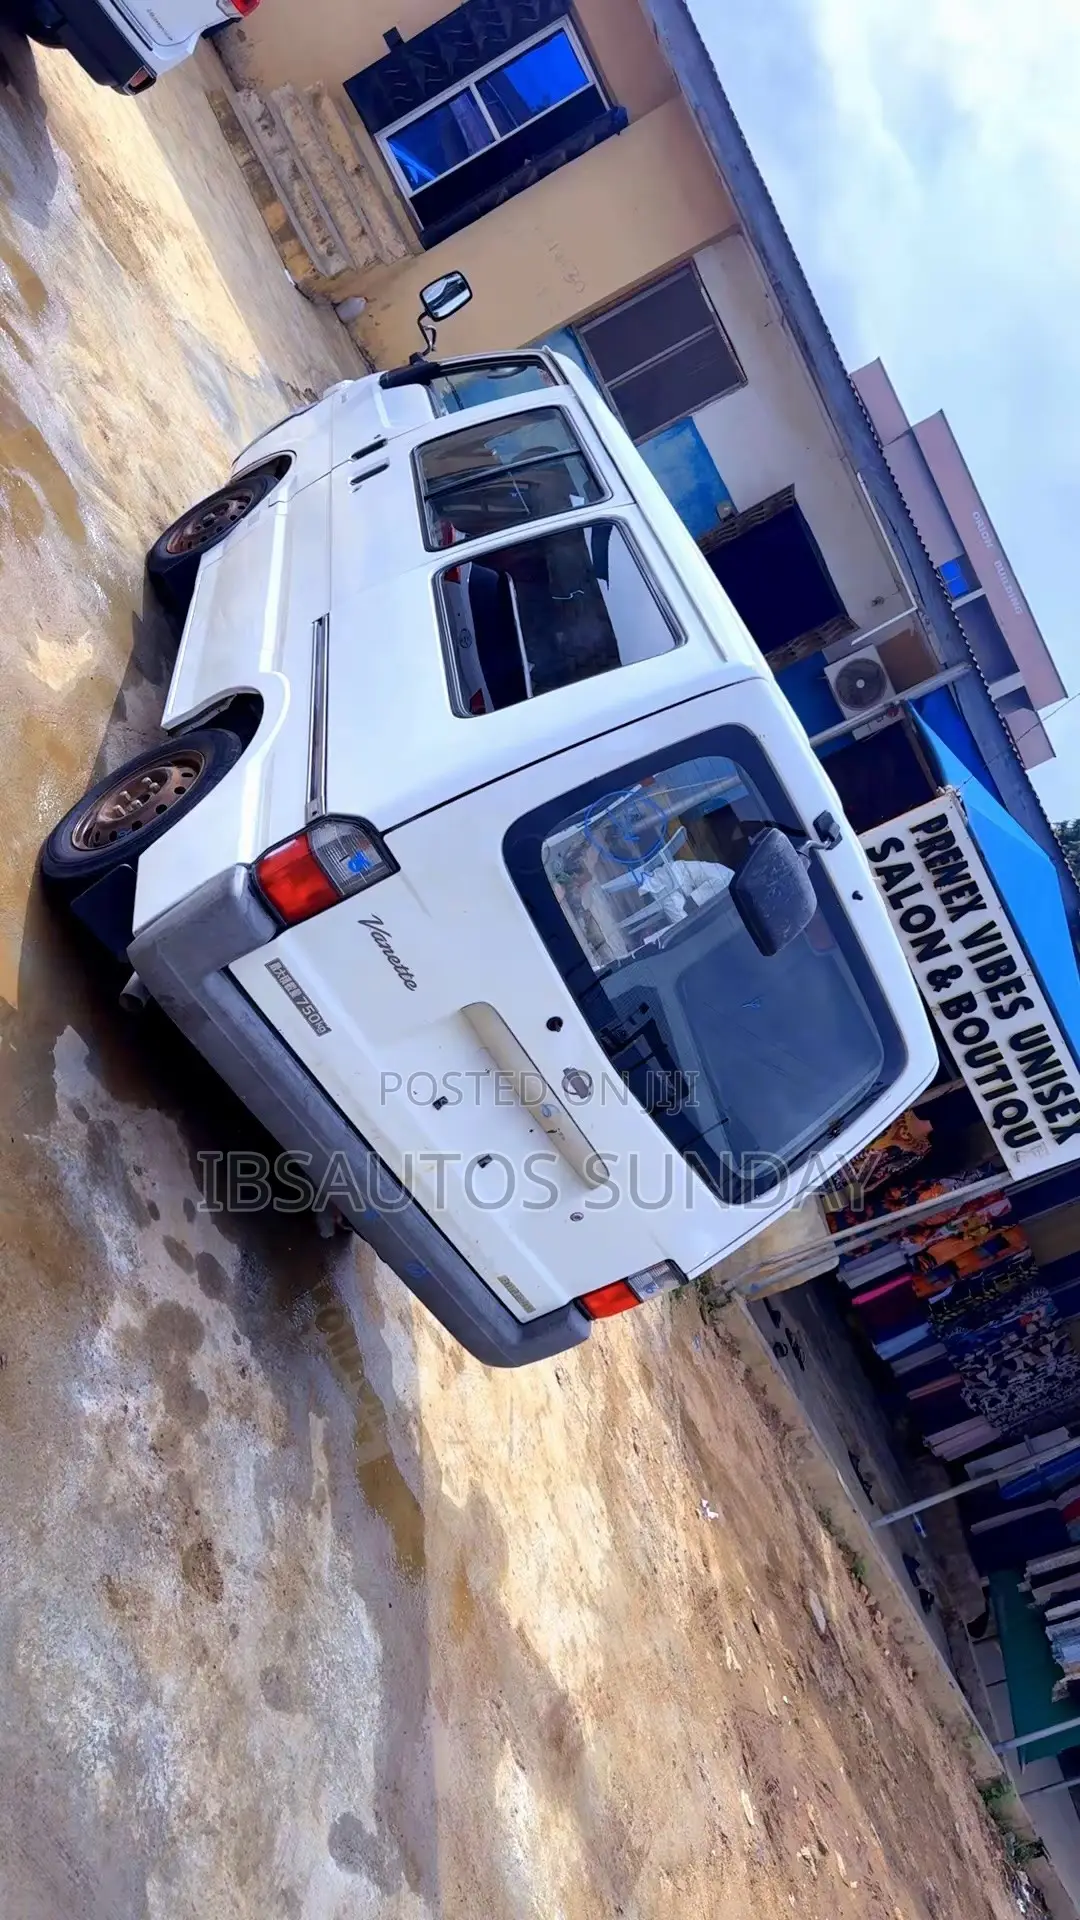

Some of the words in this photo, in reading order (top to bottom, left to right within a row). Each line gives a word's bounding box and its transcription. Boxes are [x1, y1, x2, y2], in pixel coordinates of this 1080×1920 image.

[994, 560, 1023, 615] BUILDING
[357, 912, 417, 992] Vanette
[866, 836, 952, 964] SALON
[926, 963, 964, 994] &
[909, 812, 987, 924] PRENEX
[960, 919, 1035, 1021] VIBES
[1008, 1023, 1080, 1146] UNISEX
